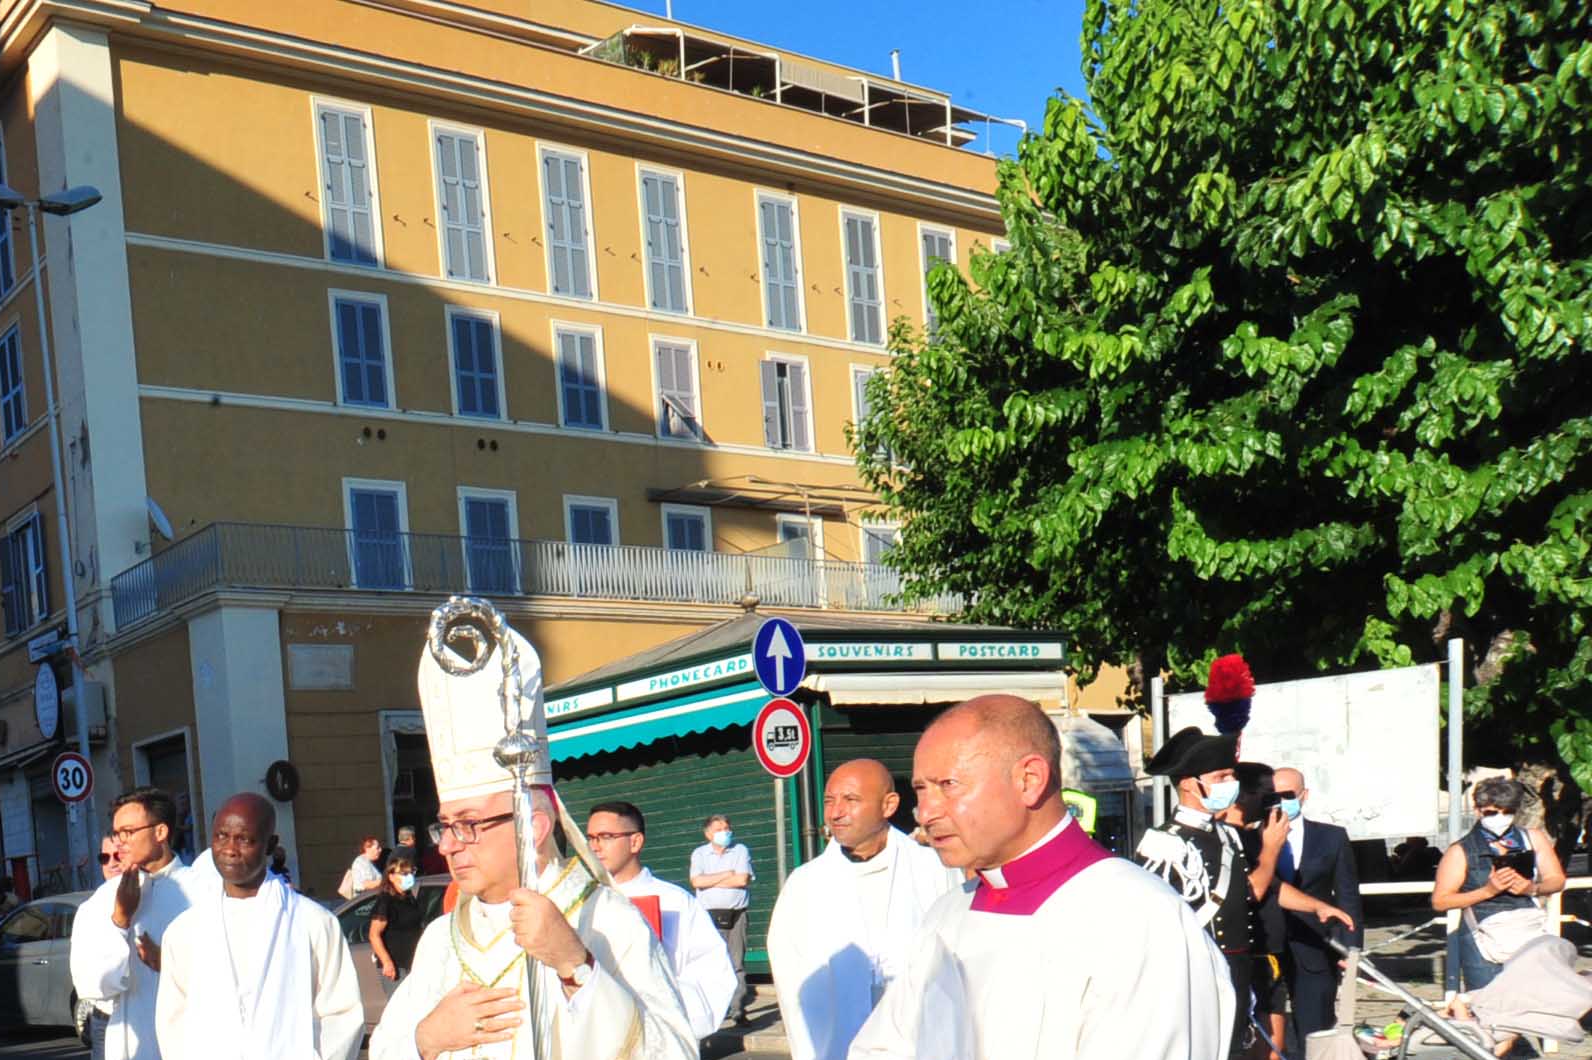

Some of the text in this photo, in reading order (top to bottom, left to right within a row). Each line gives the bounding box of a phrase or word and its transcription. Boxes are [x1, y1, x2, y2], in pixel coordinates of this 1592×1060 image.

[817, 645, 914, 658] SOUVENIRS
[959, 645, 1040, 658] POSTCARD
[648, 658, 749, 691] PHONECARD
[546, 699, 580, 715] NIRS
[60, 766, 84, 790] 30
